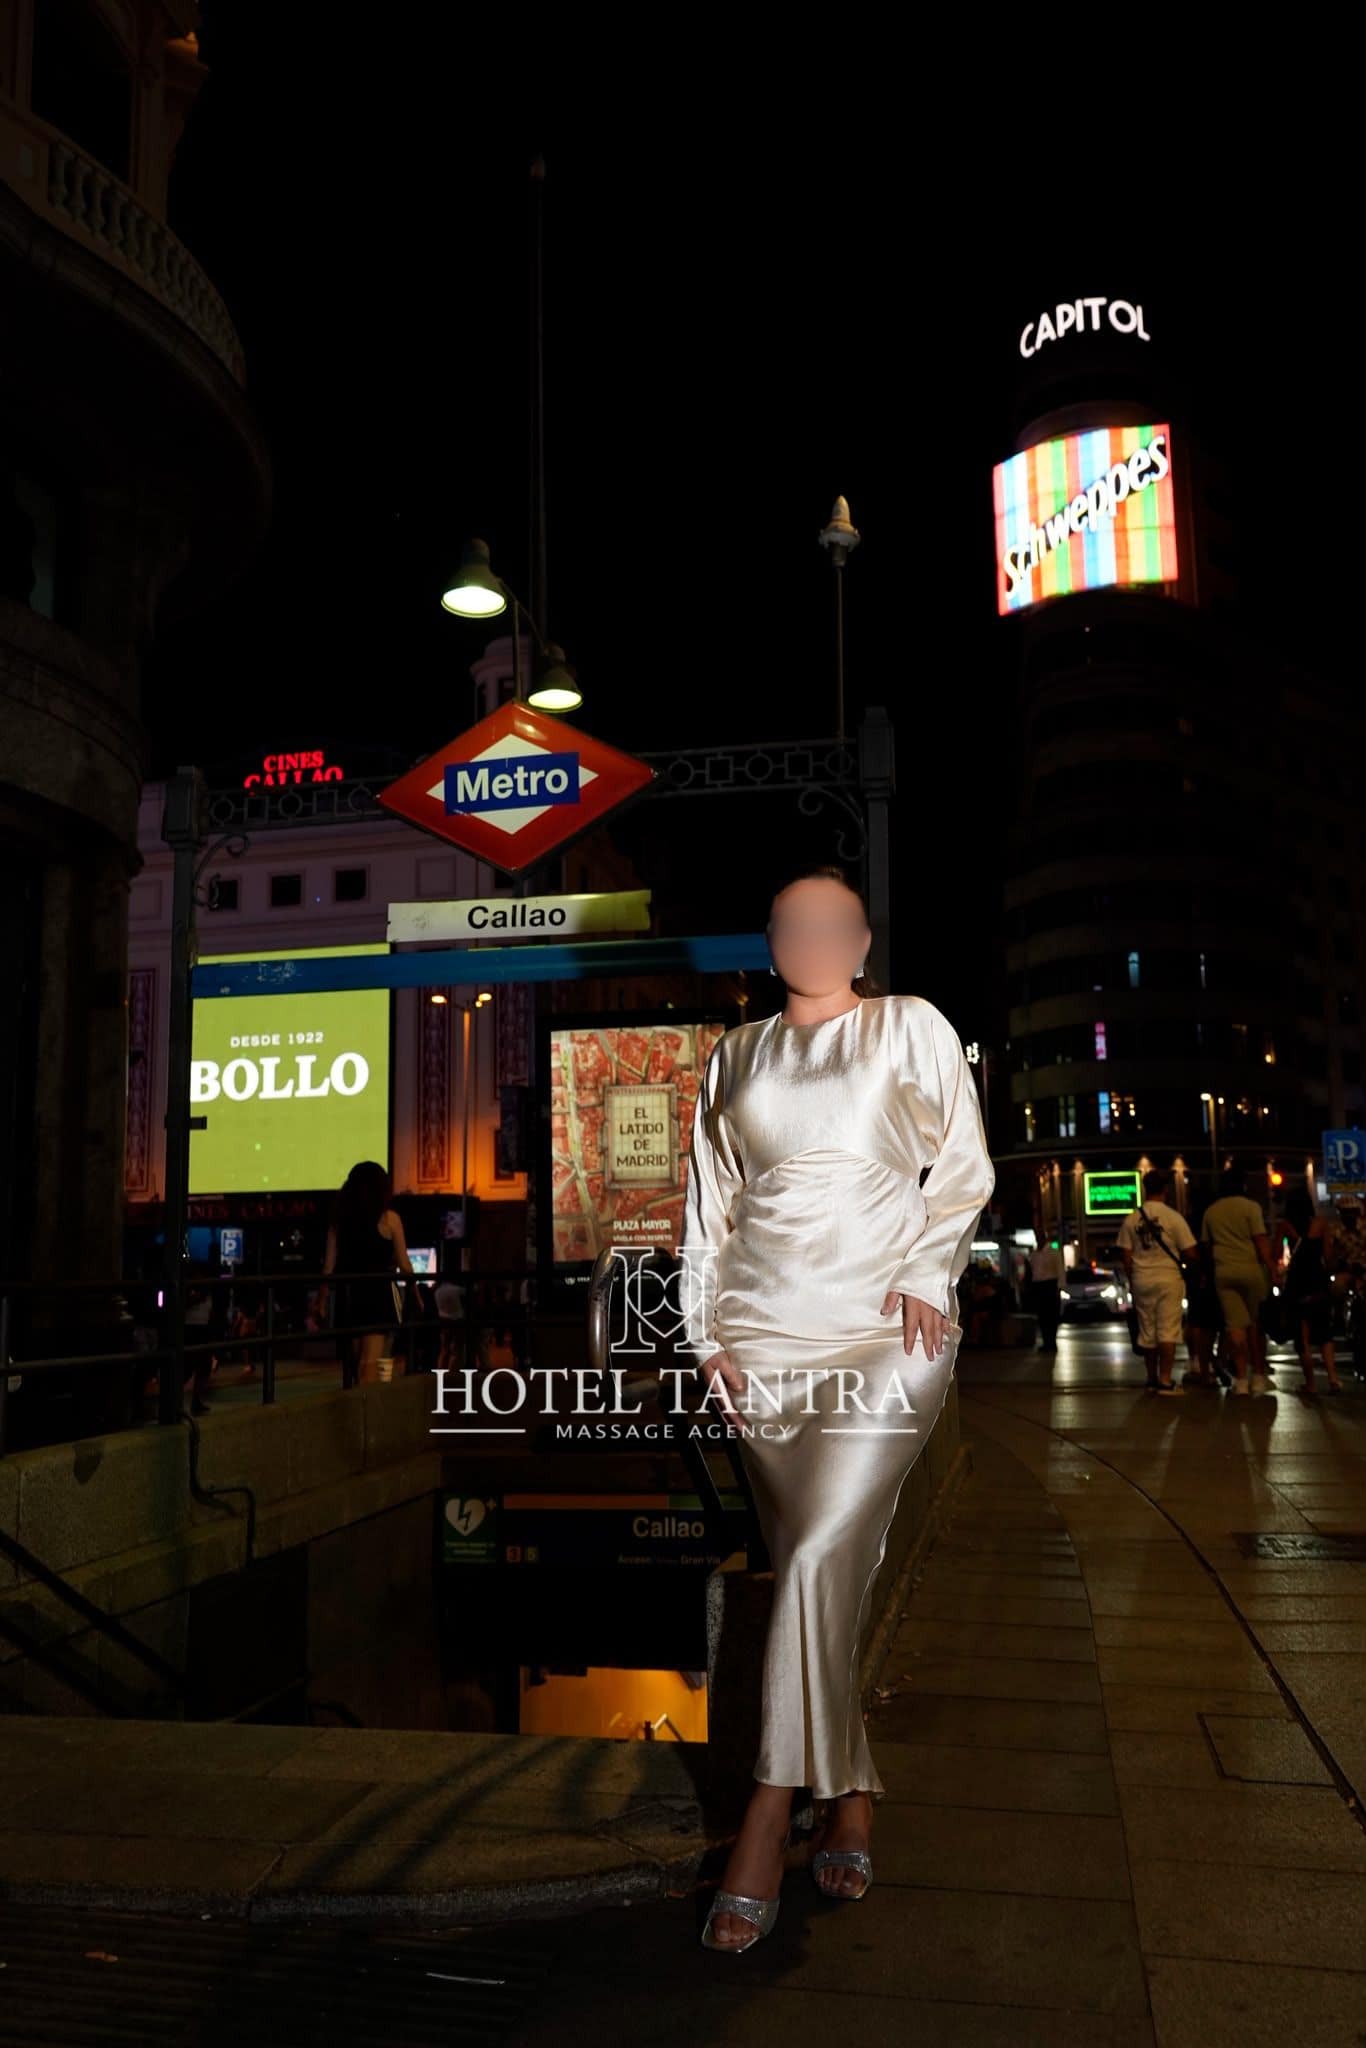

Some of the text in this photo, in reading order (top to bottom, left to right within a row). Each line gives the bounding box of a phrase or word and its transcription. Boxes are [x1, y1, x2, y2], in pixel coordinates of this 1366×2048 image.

[1019, 297, 1150, 358] CAPITOL
[1003, 435, 1169, 601] Schweppes
[263, 749, 324, 773] CINES
[456, 765, 569, 803] Metro
[467, 904, 566, 929] Callao
[230, 1031, 324, 1048] DESDE 1922
[190, 1052, 369, 1103] BOLLO
[634, 1107, 648, 1119] EL
[619, 1122, 664, 1135] LATIDO
[633, 1138, 650, 1151] DE
[616, 1153, 668, 1167] MADRID
[613, 1219, 672, 1231] PLAZA MAYOR
[225, 1241, 238, 1256] P
[631, 1515, 705, 1538] Callao
